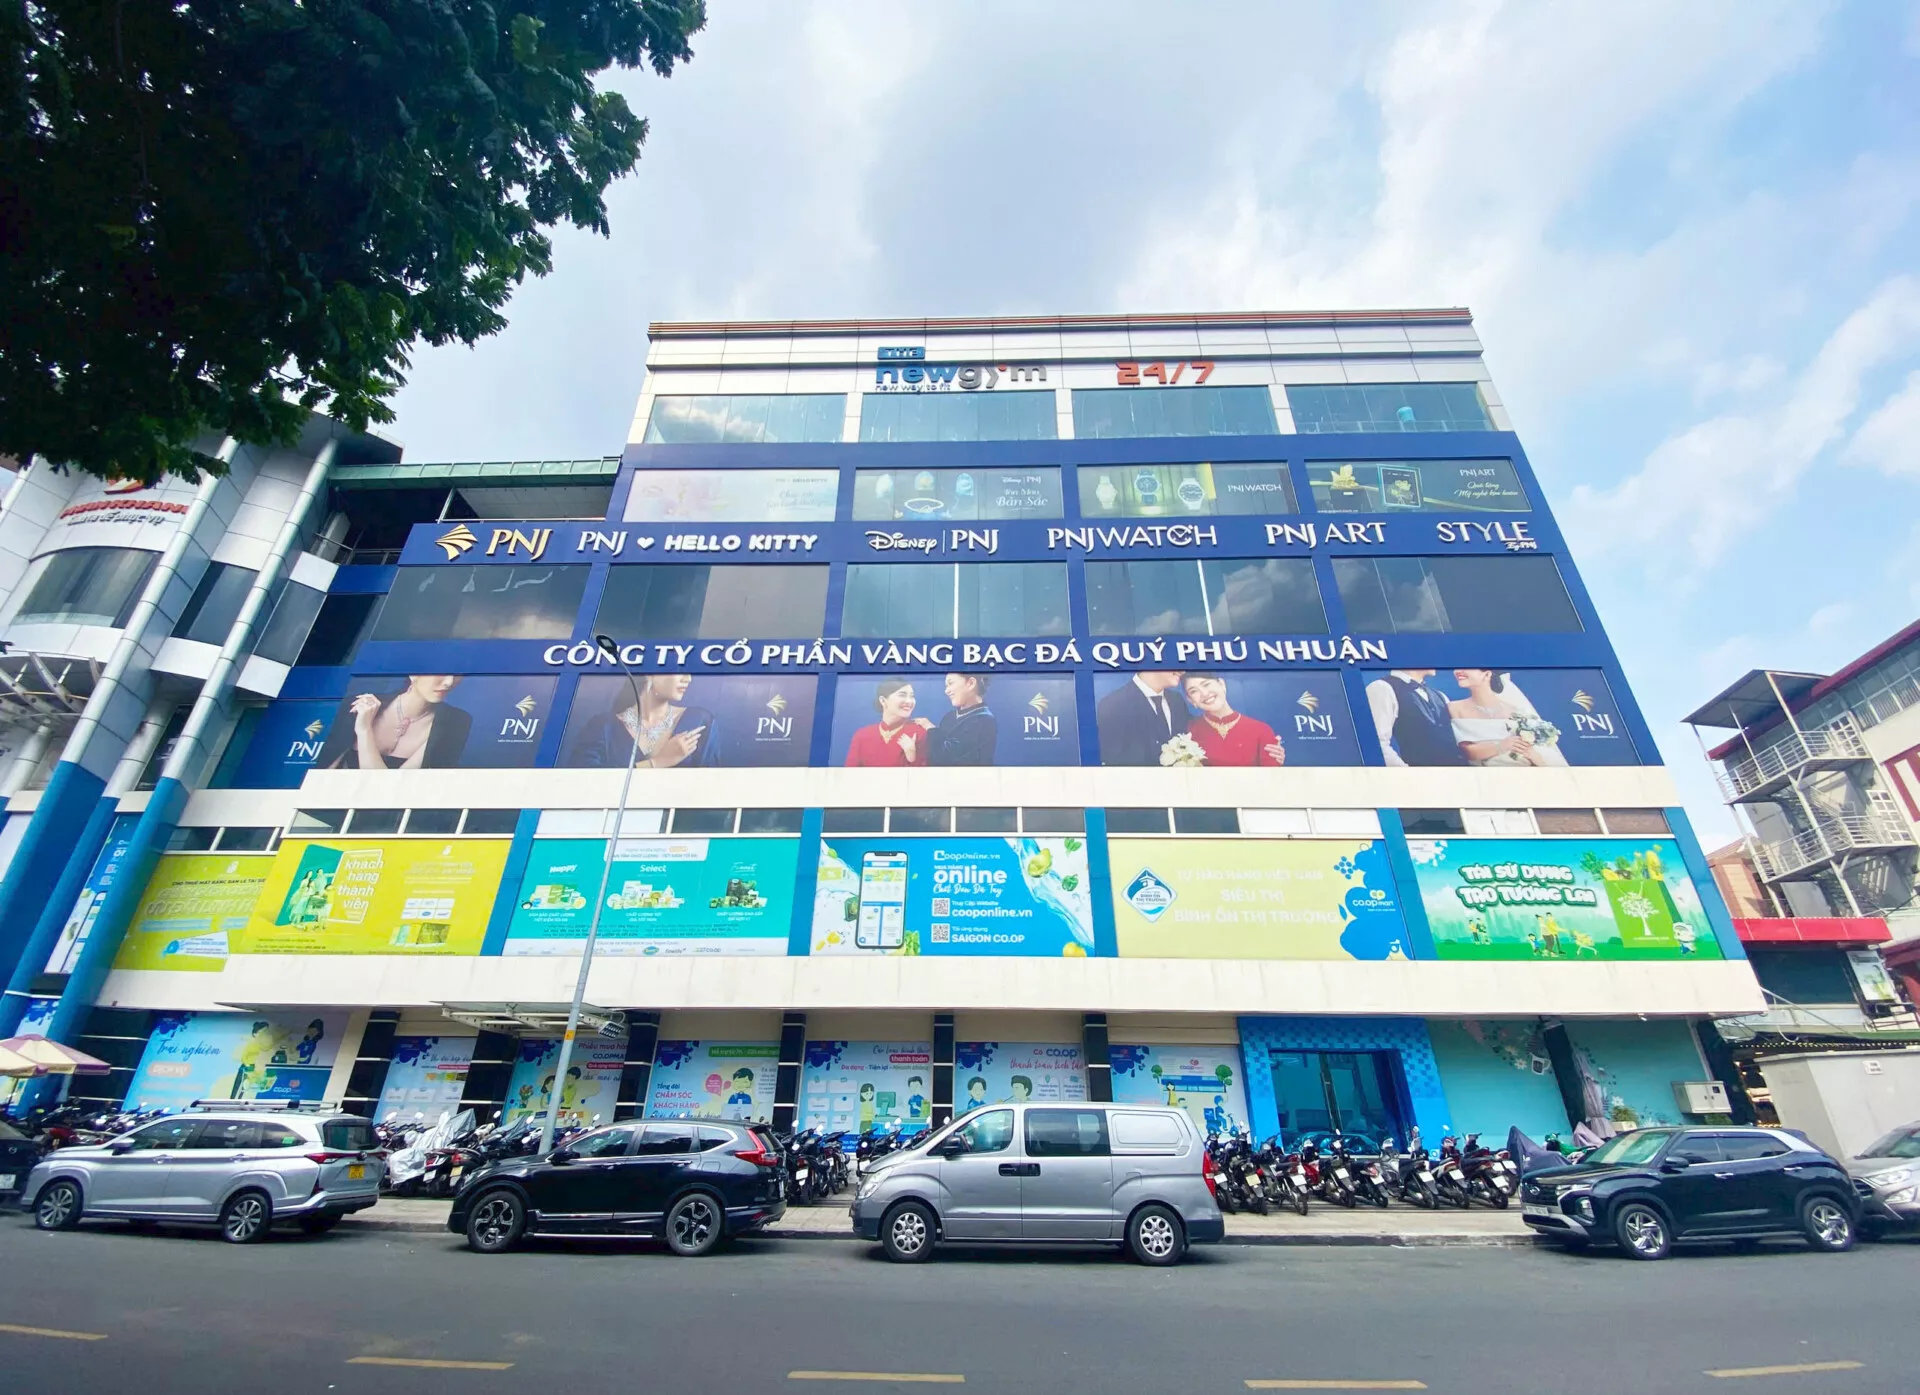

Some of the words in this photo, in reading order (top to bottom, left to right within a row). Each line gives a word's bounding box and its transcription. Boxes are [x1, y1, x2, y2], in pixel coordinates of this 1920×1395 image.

[885, 348, 918, 357] THE
[876, 363, 1047, 389] newgym
[1116, 361, 1215, 385] 24/7
[902, 384, 923, 394] way
[865, 530, 937, 555] Disney
[951, 529, 999, 554] PNJ
[1265, 523, 1317, 551] PNJ
[1324, 522, 1386, 544] ART
[1436, 521, 1534, 543] STYLE
[485, 527, 552, 560] PNJ
[576, 530, 628, 557] PNJ
[664, 534, 740, 552] HELLO
[748, 533, 818, 552] KITTY
[543, 641, 645, 666] CÔNG
[655, 645, 693, 665] TY
[701, 638, 753, 665] CỔ
[761, 637, 852, 665] PHẦN
[861, 640, 953, 665] VÀNG
[962, 643, 1027, 668] BẠC
[1035, 638, 1083, 664] ĐÁ
[1092, 637, 1166, 669] QUÝ
[1176, 637, 1248, 662] PHÚ
[1259, 636, 1389, 665] NHUẬN
[500, 718, 539, 739] PNJ
[756, 717, 794, 738] PNJ
[1023, 716, 1059, 735] PNJ
[1294, 714, 1334, 736] PNJ
[1571, 713, 1615, 735] PNJ
[288, 741, 326, 761] PNJ
[640, 864, 667, 872] Select
[933, 864, 1008, 884] online
[951, 907, 1033, 919] cooponline.vn
[951, 934, 991, 943] SAIGON
[993, 934, 1025, 943] CO.OP
[678, 1090, 693, 1098] SÓC
